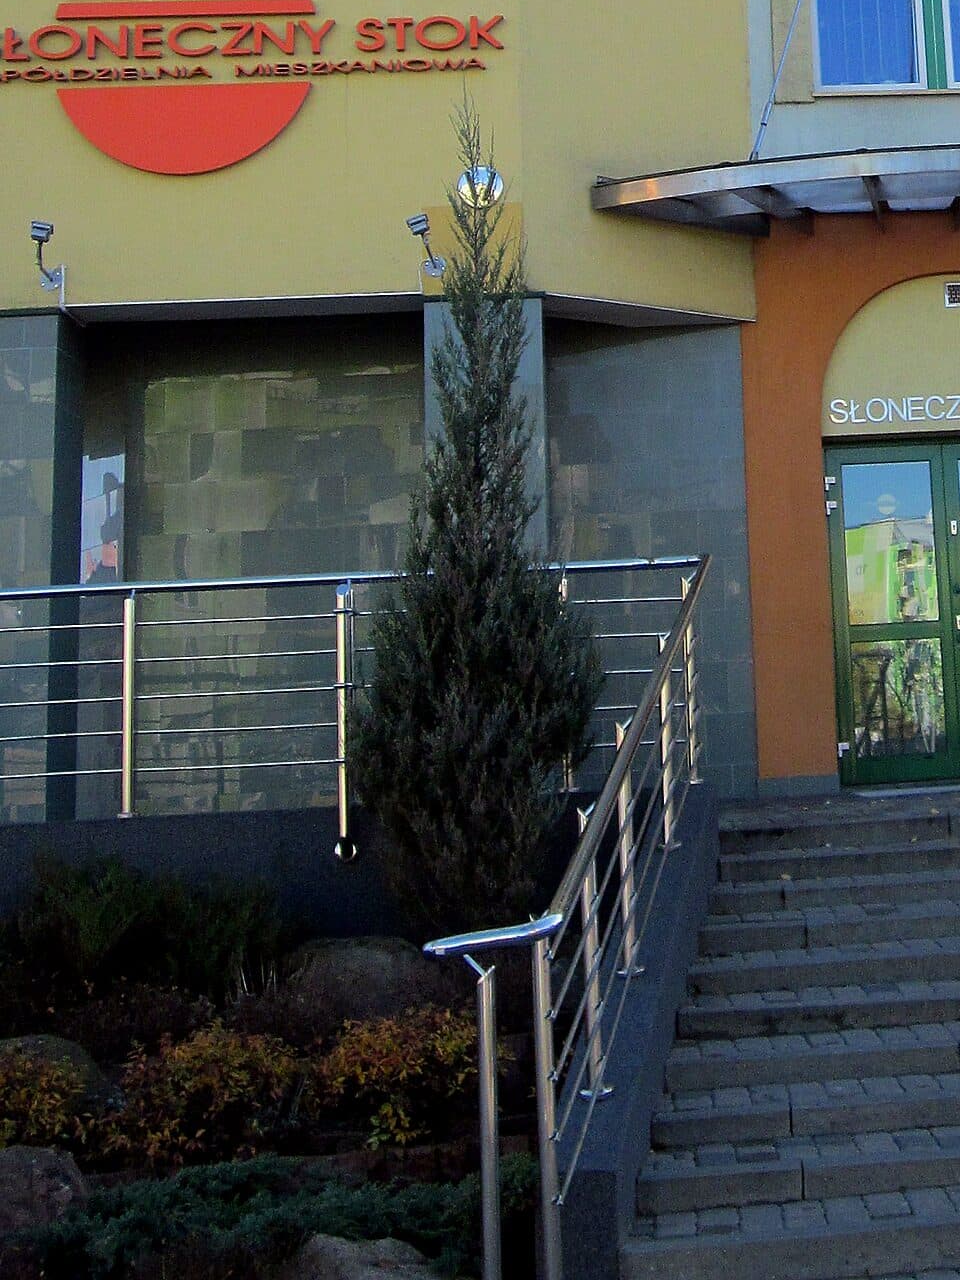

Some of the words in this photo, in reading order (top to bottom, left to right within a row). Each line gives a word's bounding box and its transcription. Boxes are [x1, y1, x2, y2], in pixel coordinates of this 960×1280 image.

[0, 19, 336, 62] ŁONECZNY
[355, 15, 504, 52] STOK
[0, 65, 213, 84] PÓŁDZIELNIA
[234, 57, 487, 77] MIESZKANIOWA
